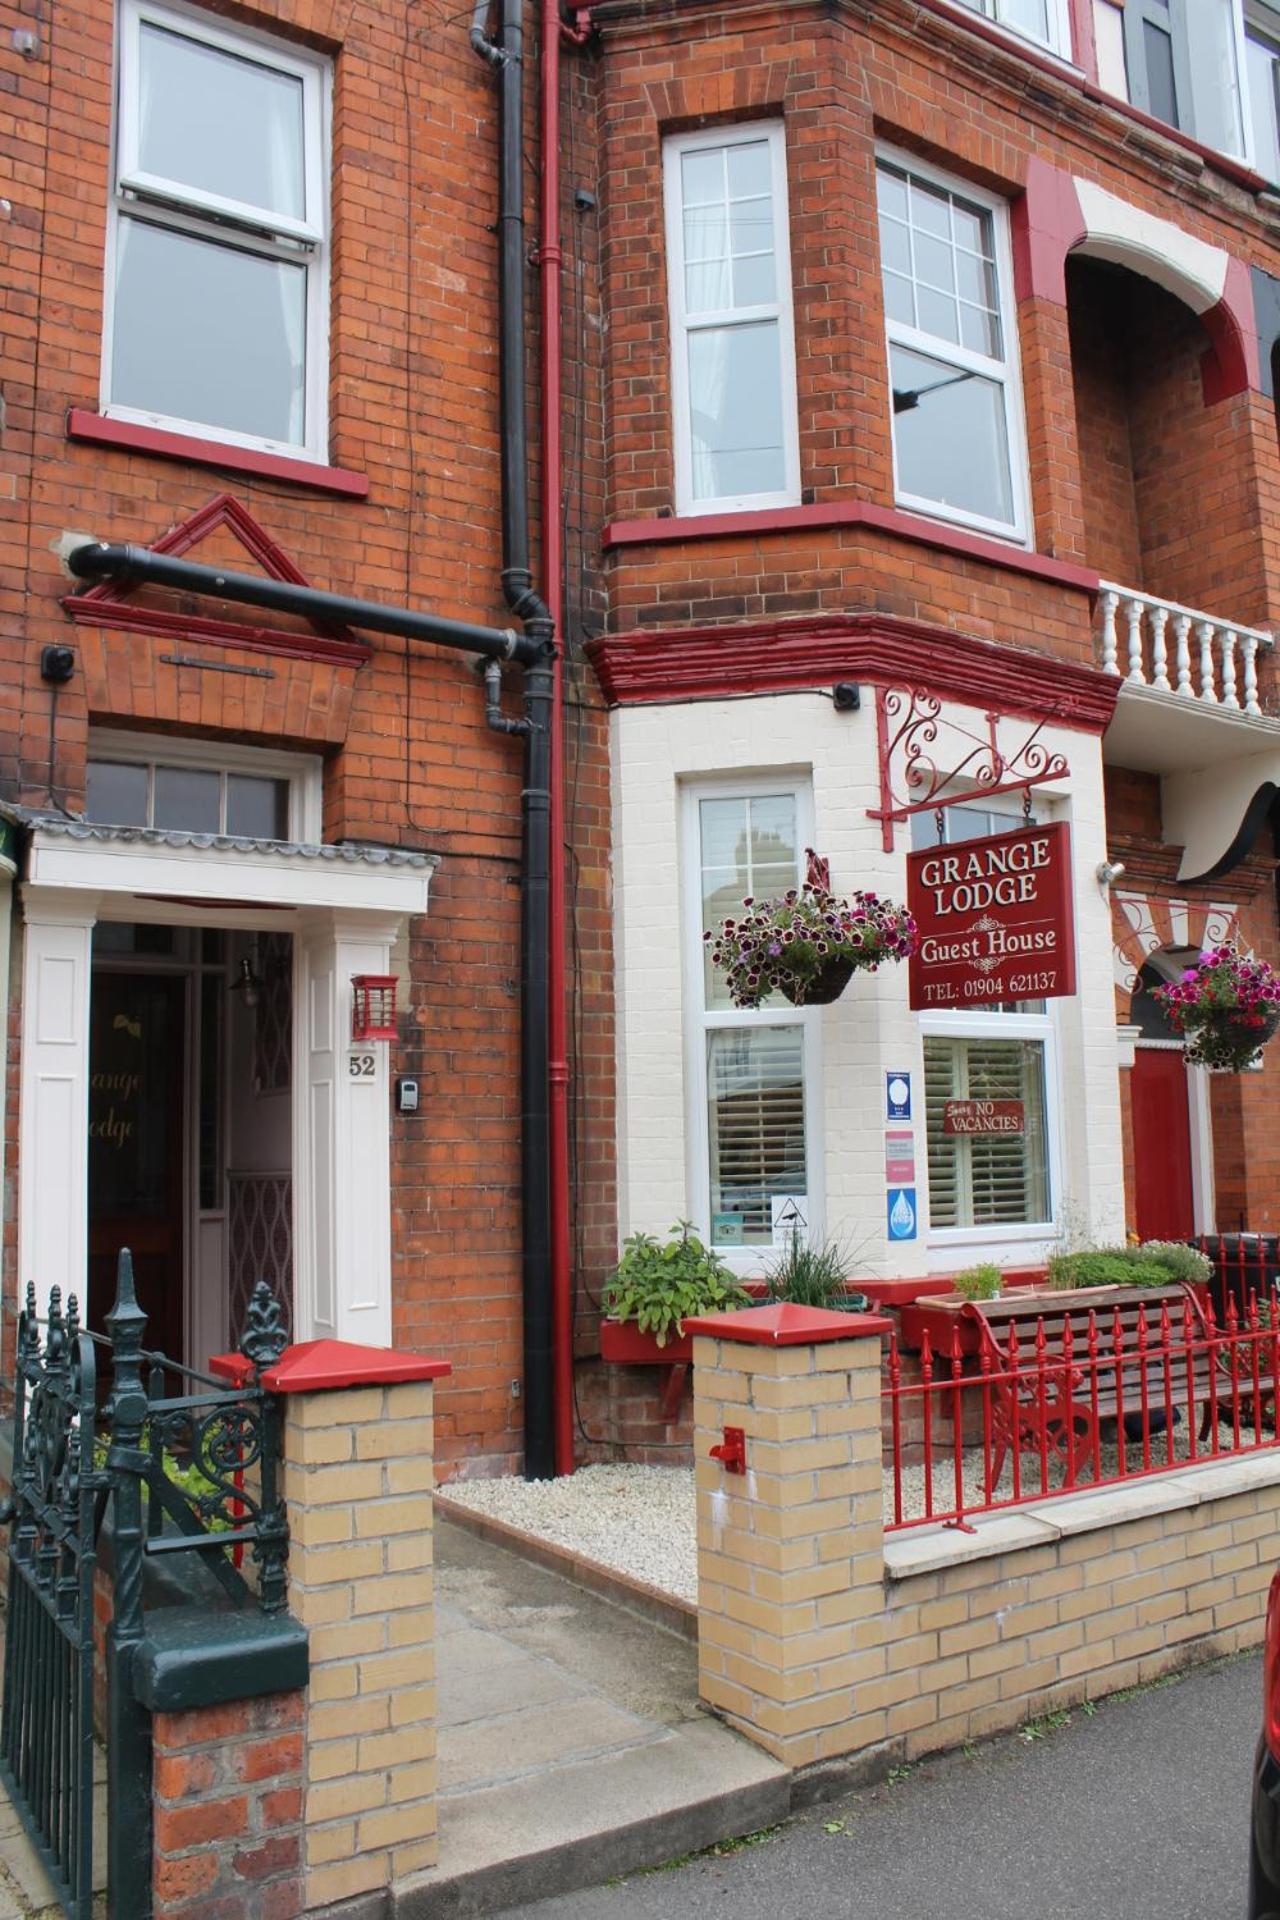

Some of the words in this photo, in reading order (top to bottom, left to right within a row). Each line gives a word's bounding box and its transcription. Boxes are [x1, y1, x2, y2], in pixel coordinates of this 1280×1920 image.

[920, 838, 1052, 888] GRANGE
[934, 873, 1038, 915] LODGE
[921, 939, 980, 963] Guest
[987, 929, 1056, 955] House
[923, 982, 960, 1002] TEL:
[964, 977, 1004, 998] 01904
[1009, 971, 1057, 992] 621137
[349, 1056, 375, 1076] 52
[951, 1115, 1019, 1132] VACANCIES
[976, 1101, 995, 1116] NO
